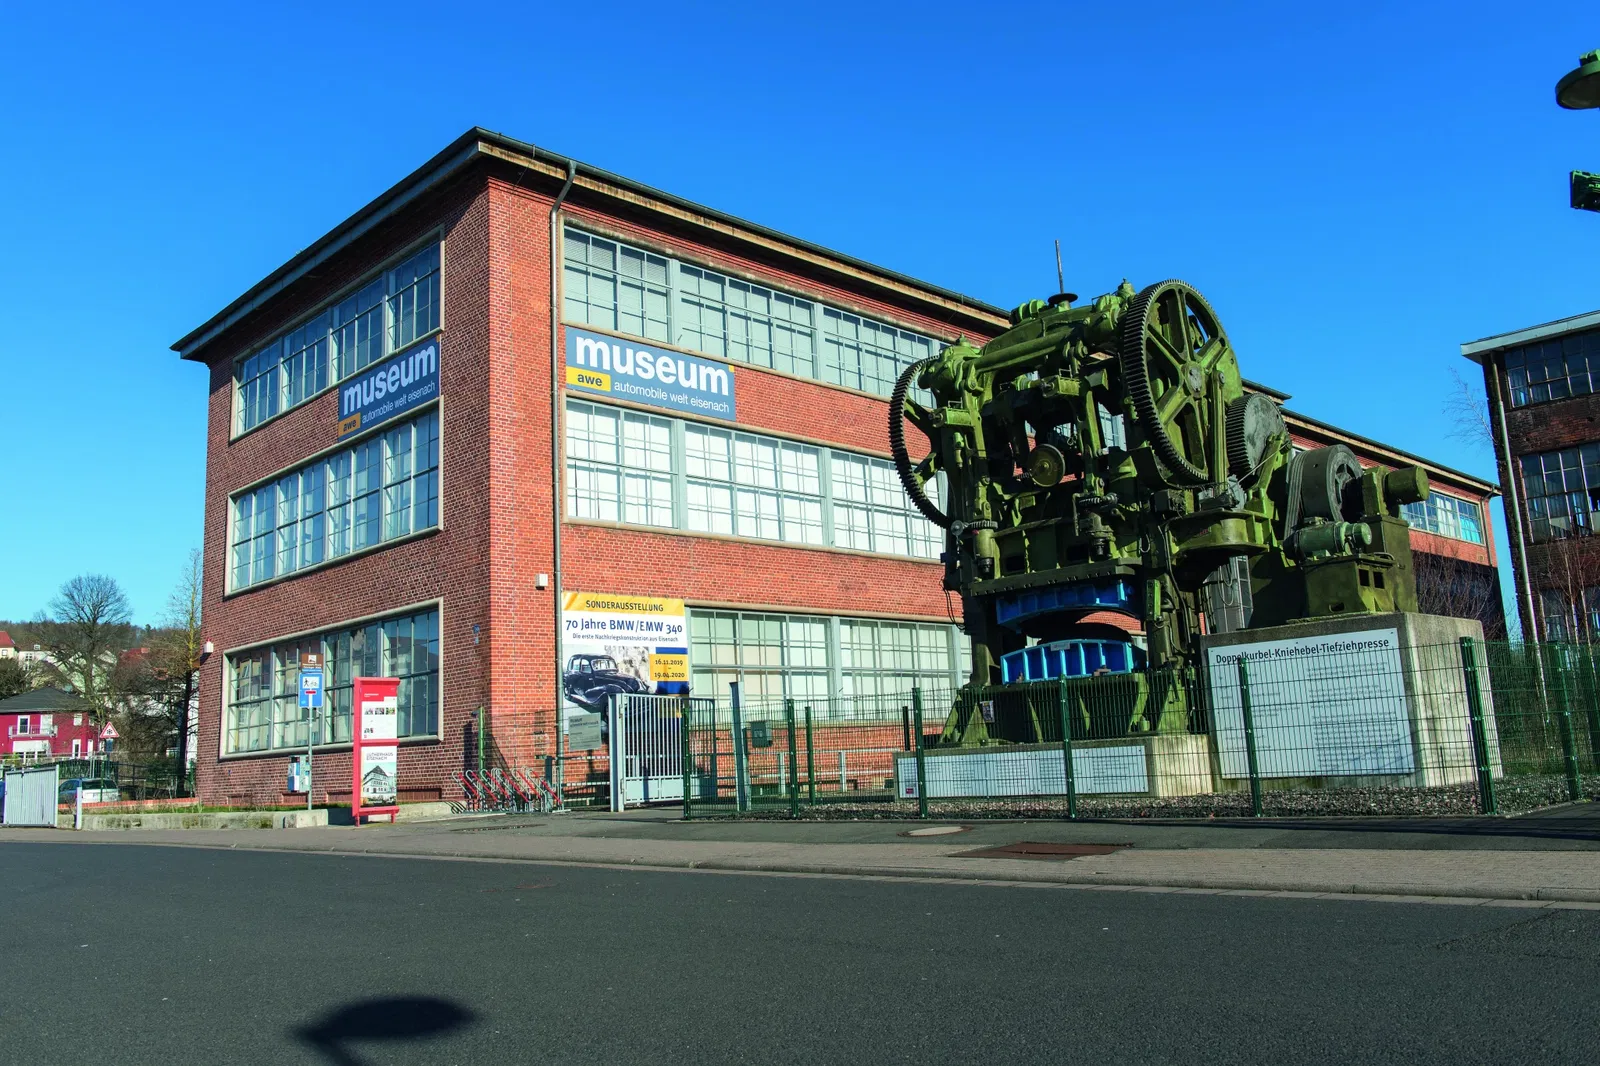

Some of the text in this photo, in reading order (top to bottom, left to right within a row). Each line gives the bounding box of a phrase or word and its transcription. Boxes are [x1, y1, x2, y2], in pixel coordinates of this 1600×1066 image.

[576, 336, 729, 396] museum
[343, 345, 436, 416] museum
[577, 373, 603, 387] awe
[362, 380, 436, 424] automobile welt eisenach
[614, 381, 730, 413] automobile welt eisenach
[343, 419, 357, 432] awe
[586, 600, 664, 612] SONDERAUSSTELLUNG
[565, 620, 578, 631] 70
[581, 618, 607, 631] Jahre
[666, 624, 683, 634] 340
[654, 672, 685, 680] 19.04.2020
